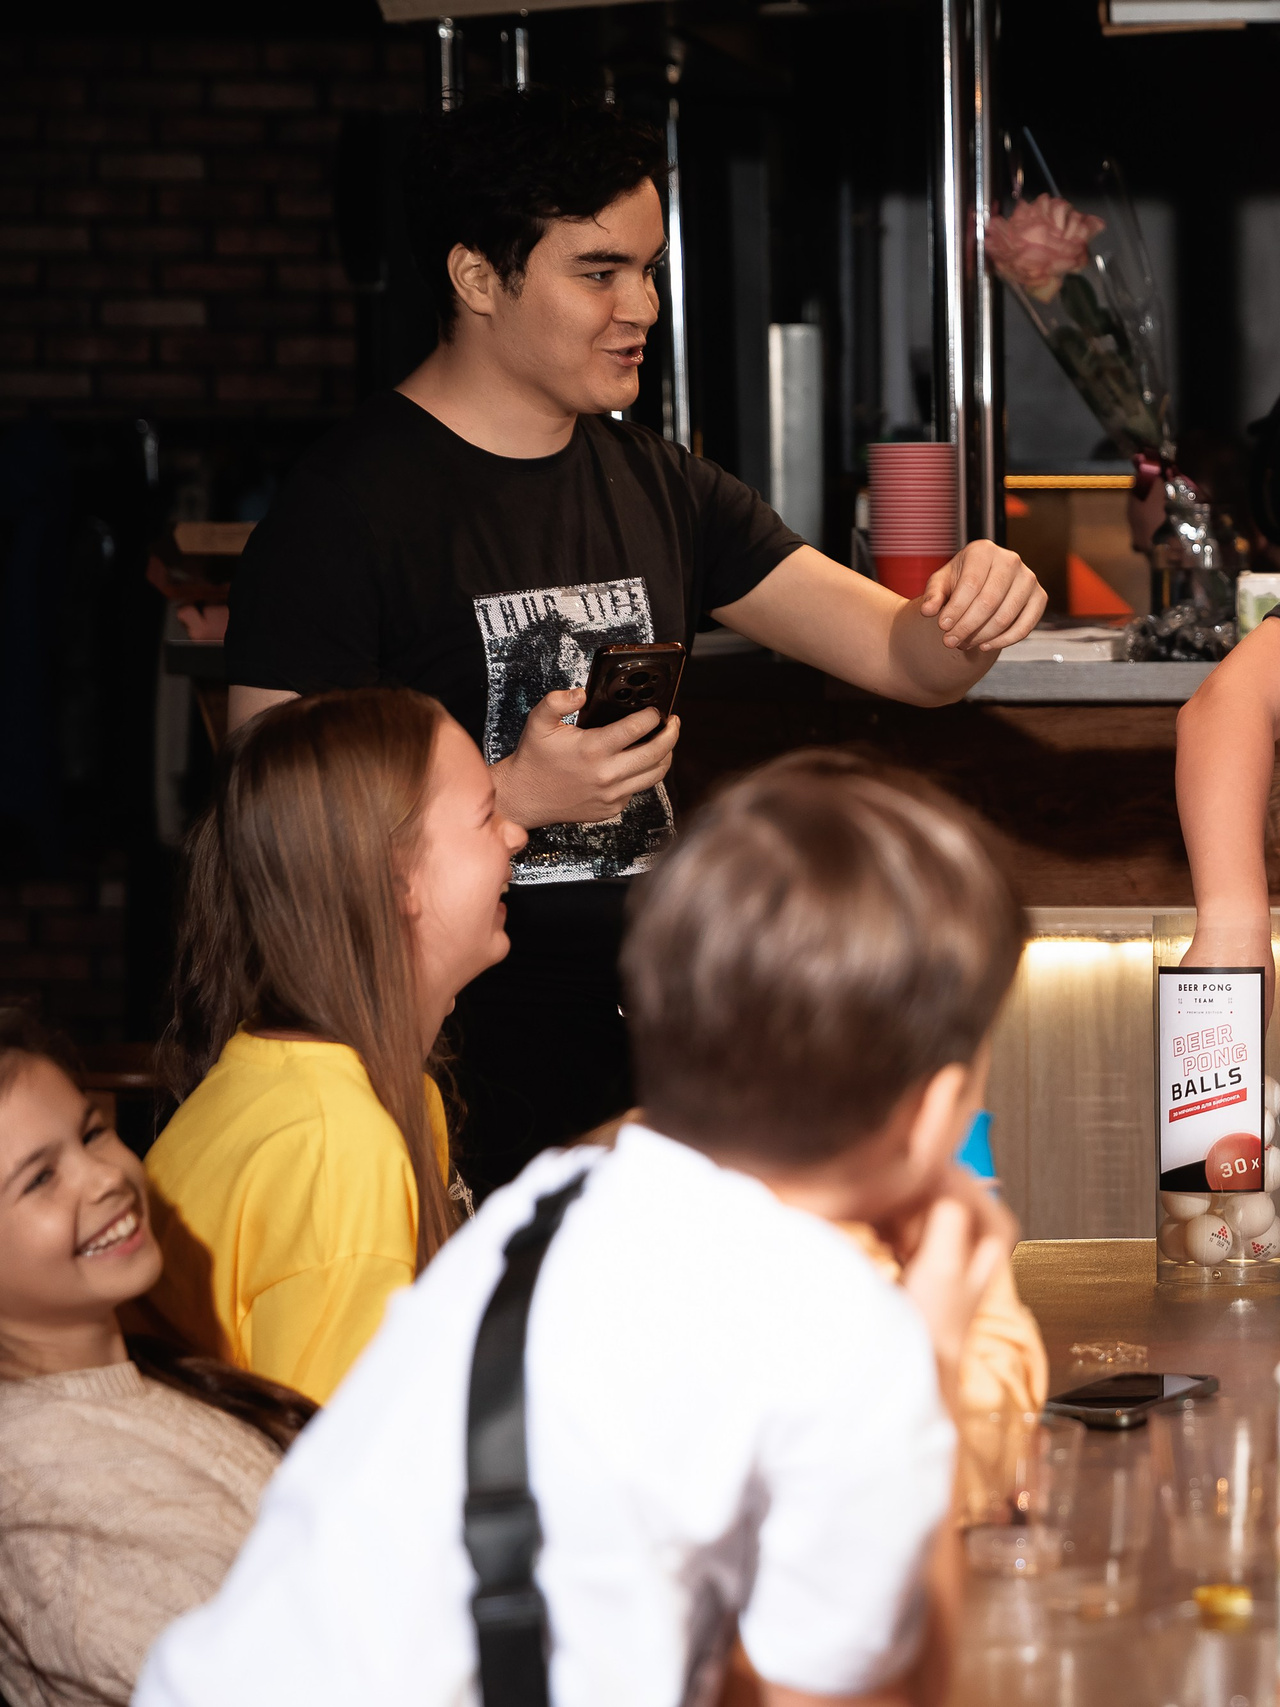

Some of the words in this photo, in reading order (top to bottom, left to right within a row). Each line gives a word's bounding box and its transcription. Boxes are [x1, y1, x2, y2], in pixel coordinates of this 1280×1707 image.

[1178, 983, 1199, 992] BEER
[1202, 983, 1233, 992] PONG
[1172, 1024, 1234, 1057] BEER
[1182, 1042, 1248, 1077] PONG
[1171, 1066, 1242, 1101] BALLS
[1219, 1157, 1248, 1179] 30
